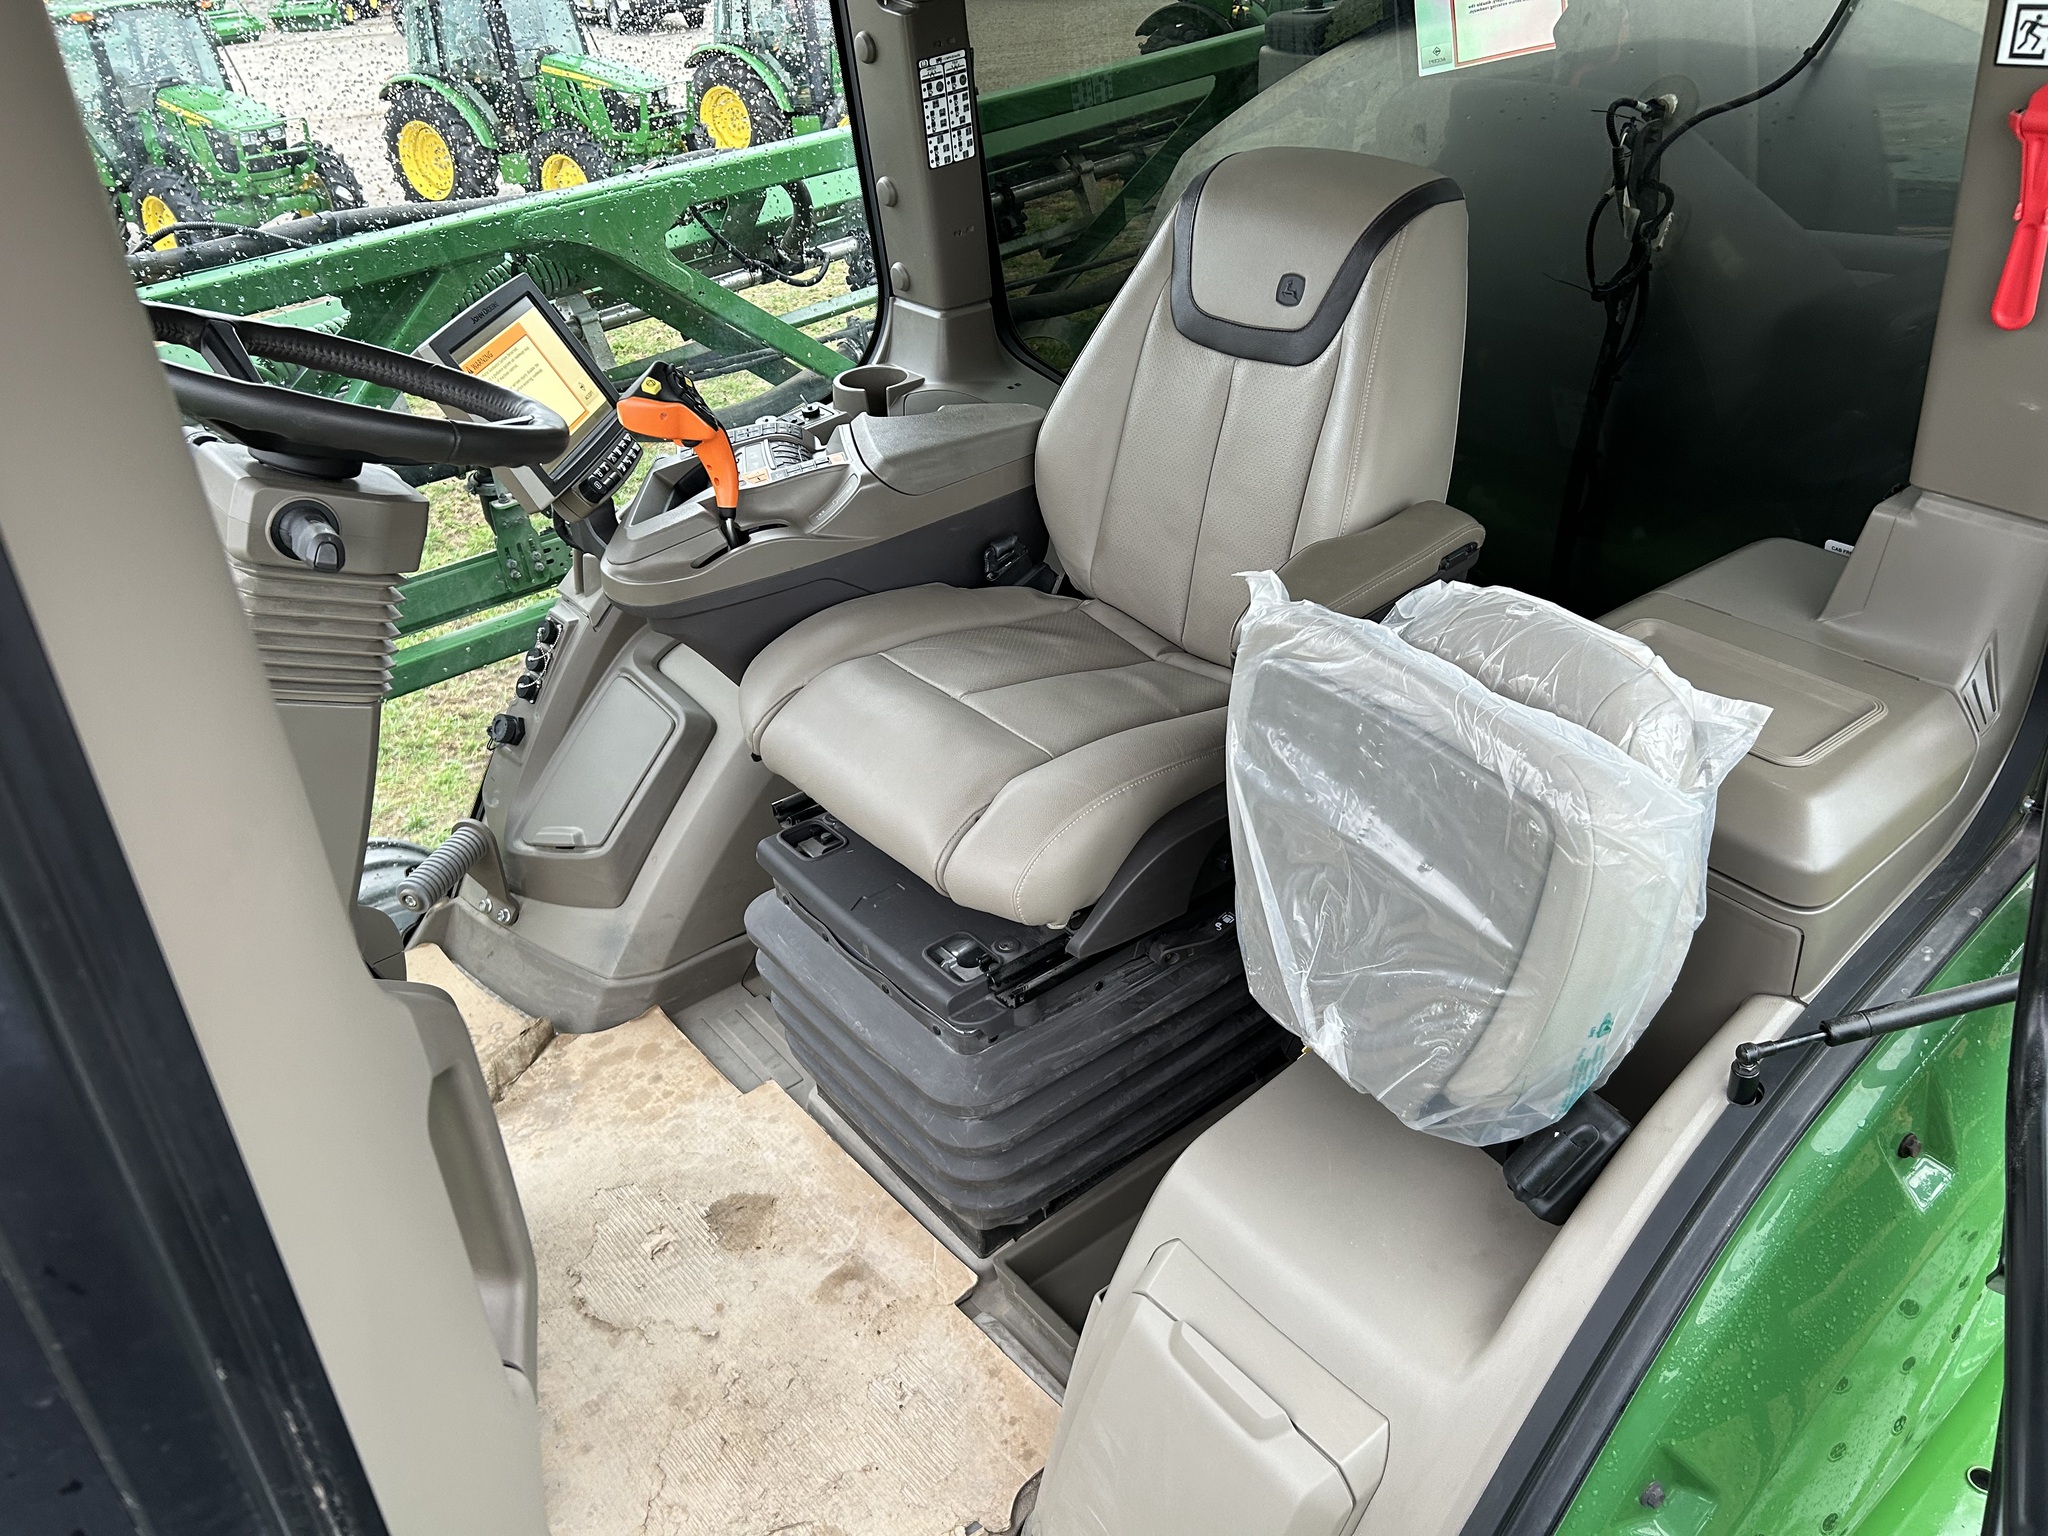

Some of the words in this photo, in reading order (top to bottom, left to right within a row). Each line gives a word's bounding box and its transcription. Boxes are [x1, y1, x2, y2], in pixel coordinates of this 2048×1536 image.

[470, 311, 485, 324] JOHN
[483, 301, 500, 315] DEERE
[471, 350, 494, 370] WARNING
